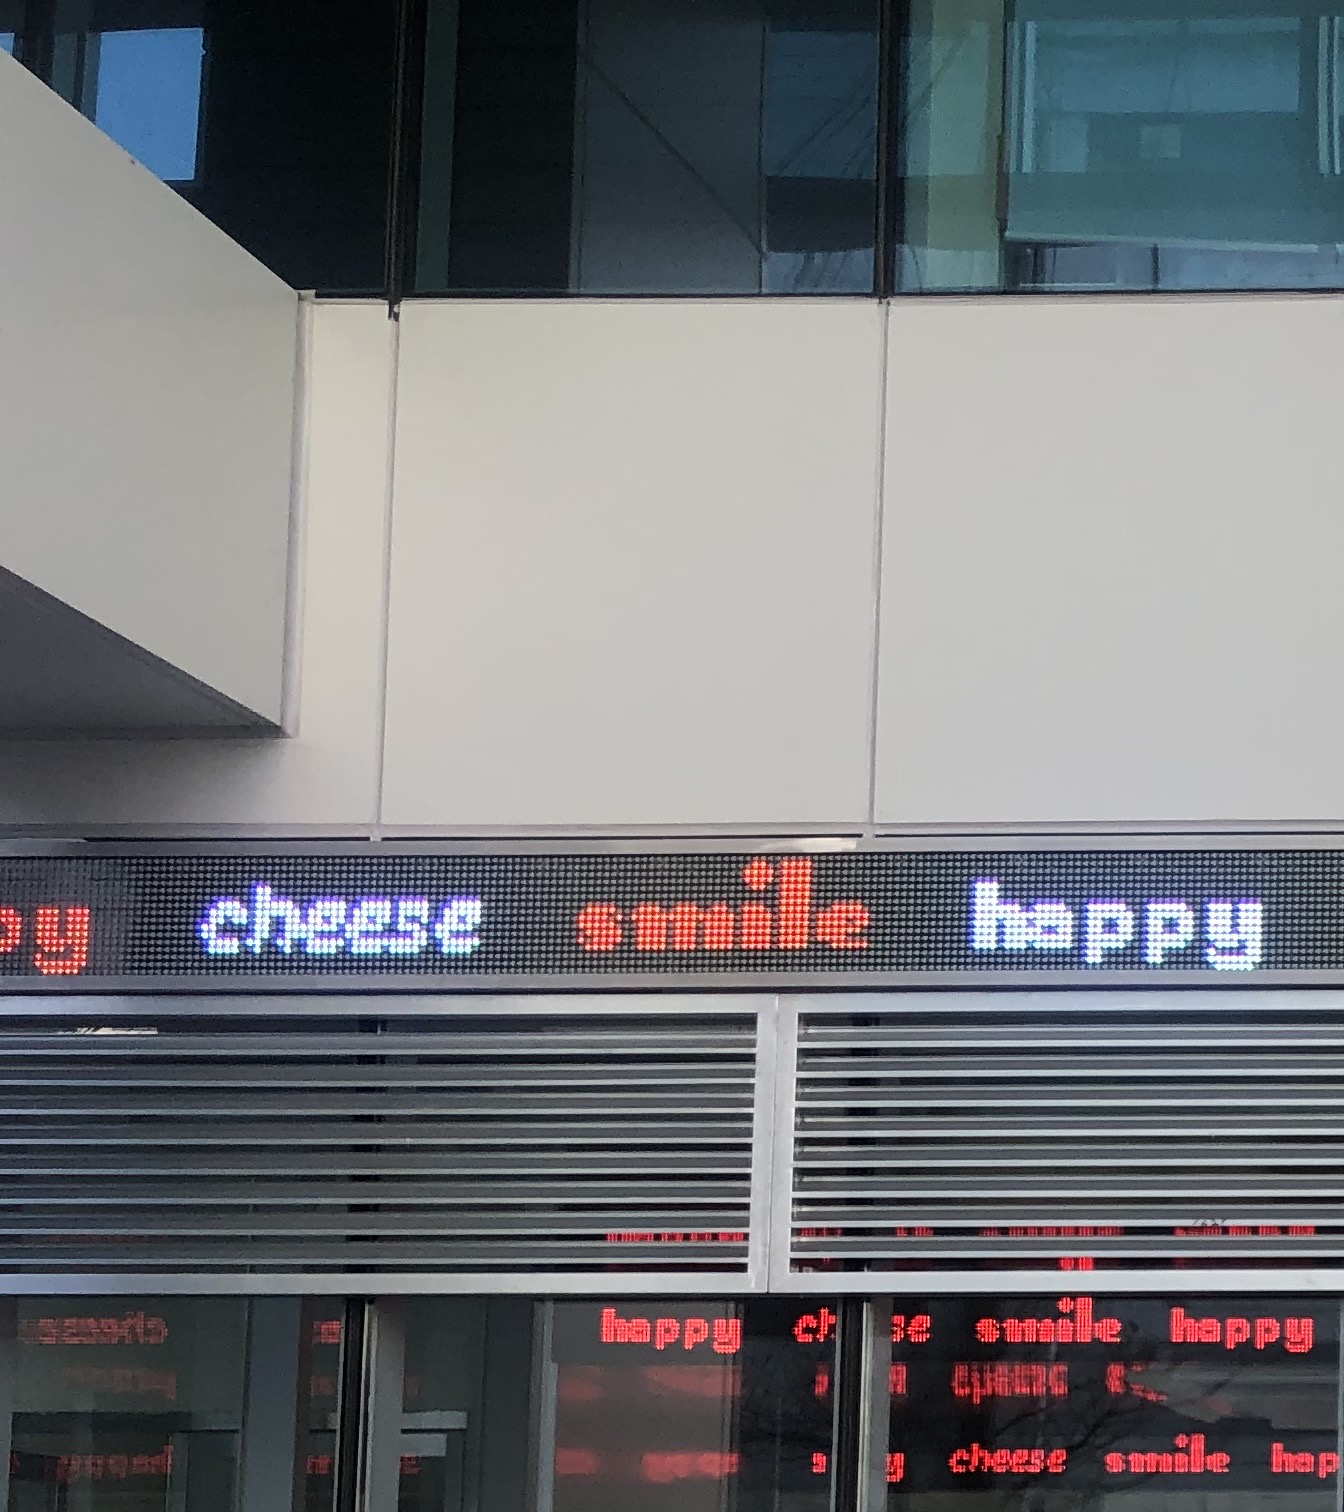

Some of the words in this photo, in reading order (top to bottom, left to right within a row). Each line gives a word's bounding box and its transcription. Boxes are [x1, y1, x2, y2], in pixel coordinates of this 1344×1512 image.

[198, 880, 482, 954] cheese
[576, 857, 869, 950] smile
[967, 876, 1263, 971] happy
[600, 1307, 742, 1354] happy
[975, 1296, 1122, 1344] smile
[1169, 1307, 1314, 1354] happy
[947, 1442, 1068, 1474] cheese
[1104, 1433, 1231, 1474] smile
